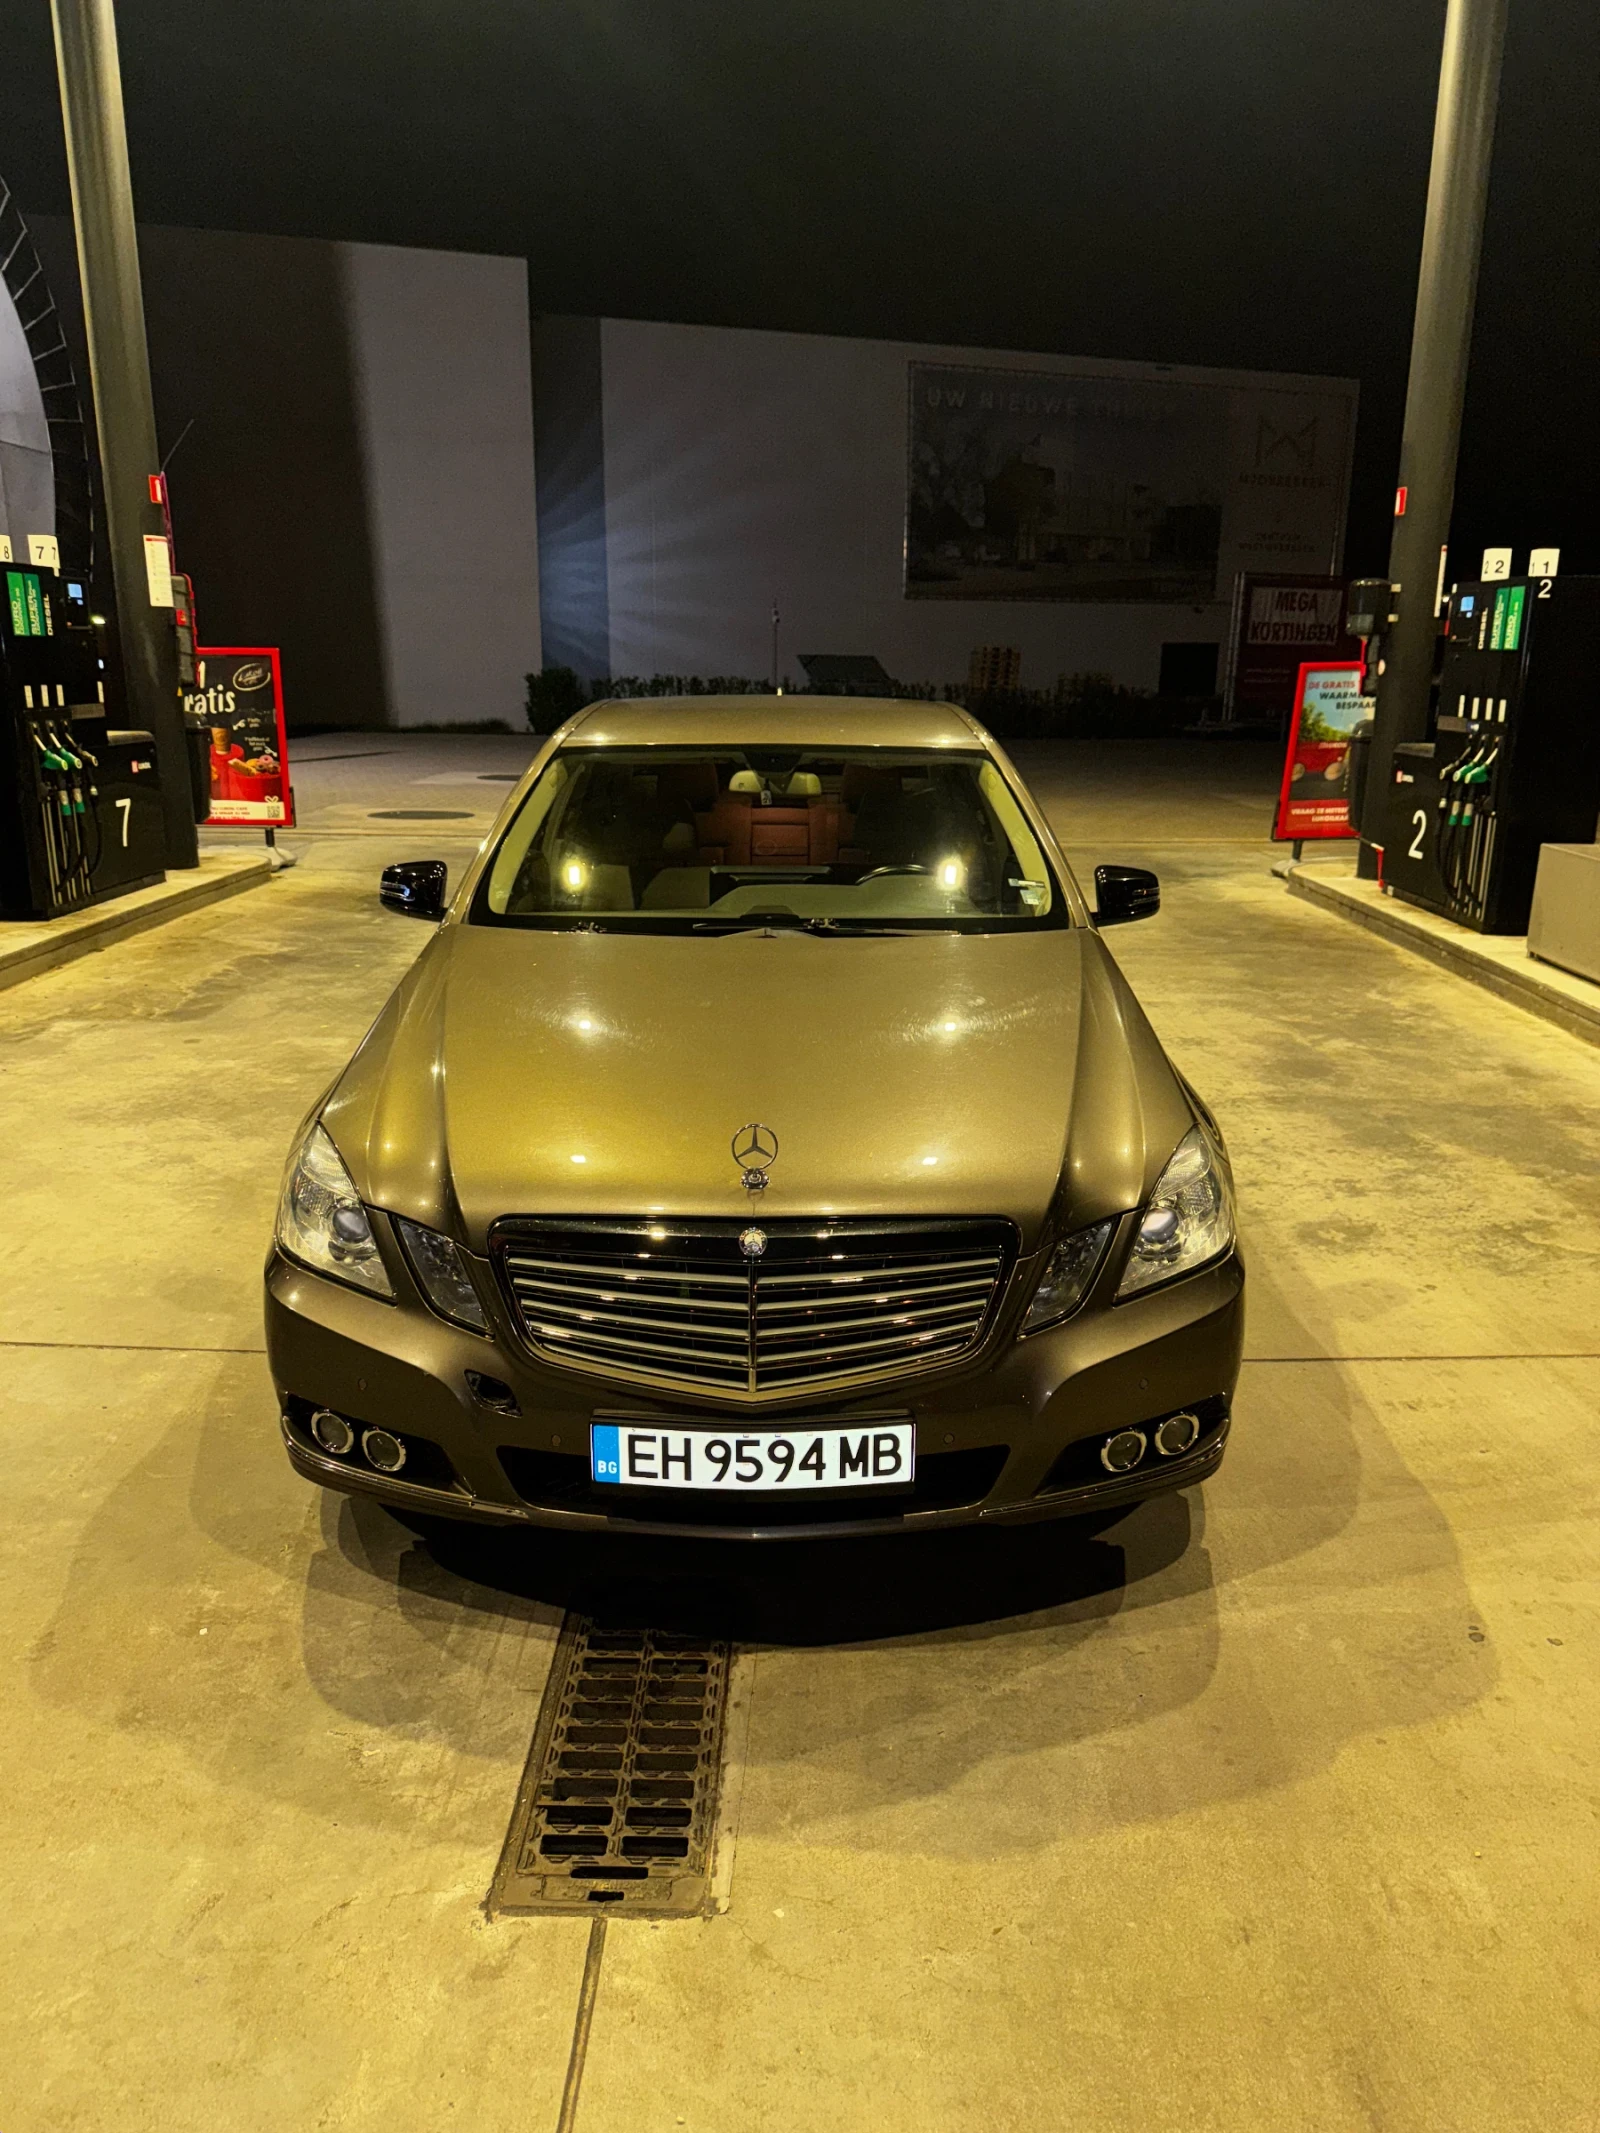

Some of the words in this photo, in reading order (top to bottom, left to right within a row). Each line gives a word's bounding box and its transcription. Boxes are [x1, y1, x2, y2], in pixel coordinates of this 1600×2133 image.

[3, 545, 10, 560] 8
[35, 545, 45, 560] 7
[1494, 559, 1505, 574] 2
[1542, 560, 1550, 574] 1
[1537, 578, 1553, 599] 2
[1275, 591, 1319, 611] MEGA
[43, 593, 54, 636] DIESEL
[1248, 621, 1337, 642] KORTINGEN
[1321, 680, 1356, 689] GRATIS
[115, 798, 131, 848] 7
[1408, 809, 1427, 860] 2
[597, 1460, 618, 1475] BG
[627, 1433, 692, 1481] EH
[704, 1437, 827, 1483] 9594
[839, 1433, 903, 1479] MB
